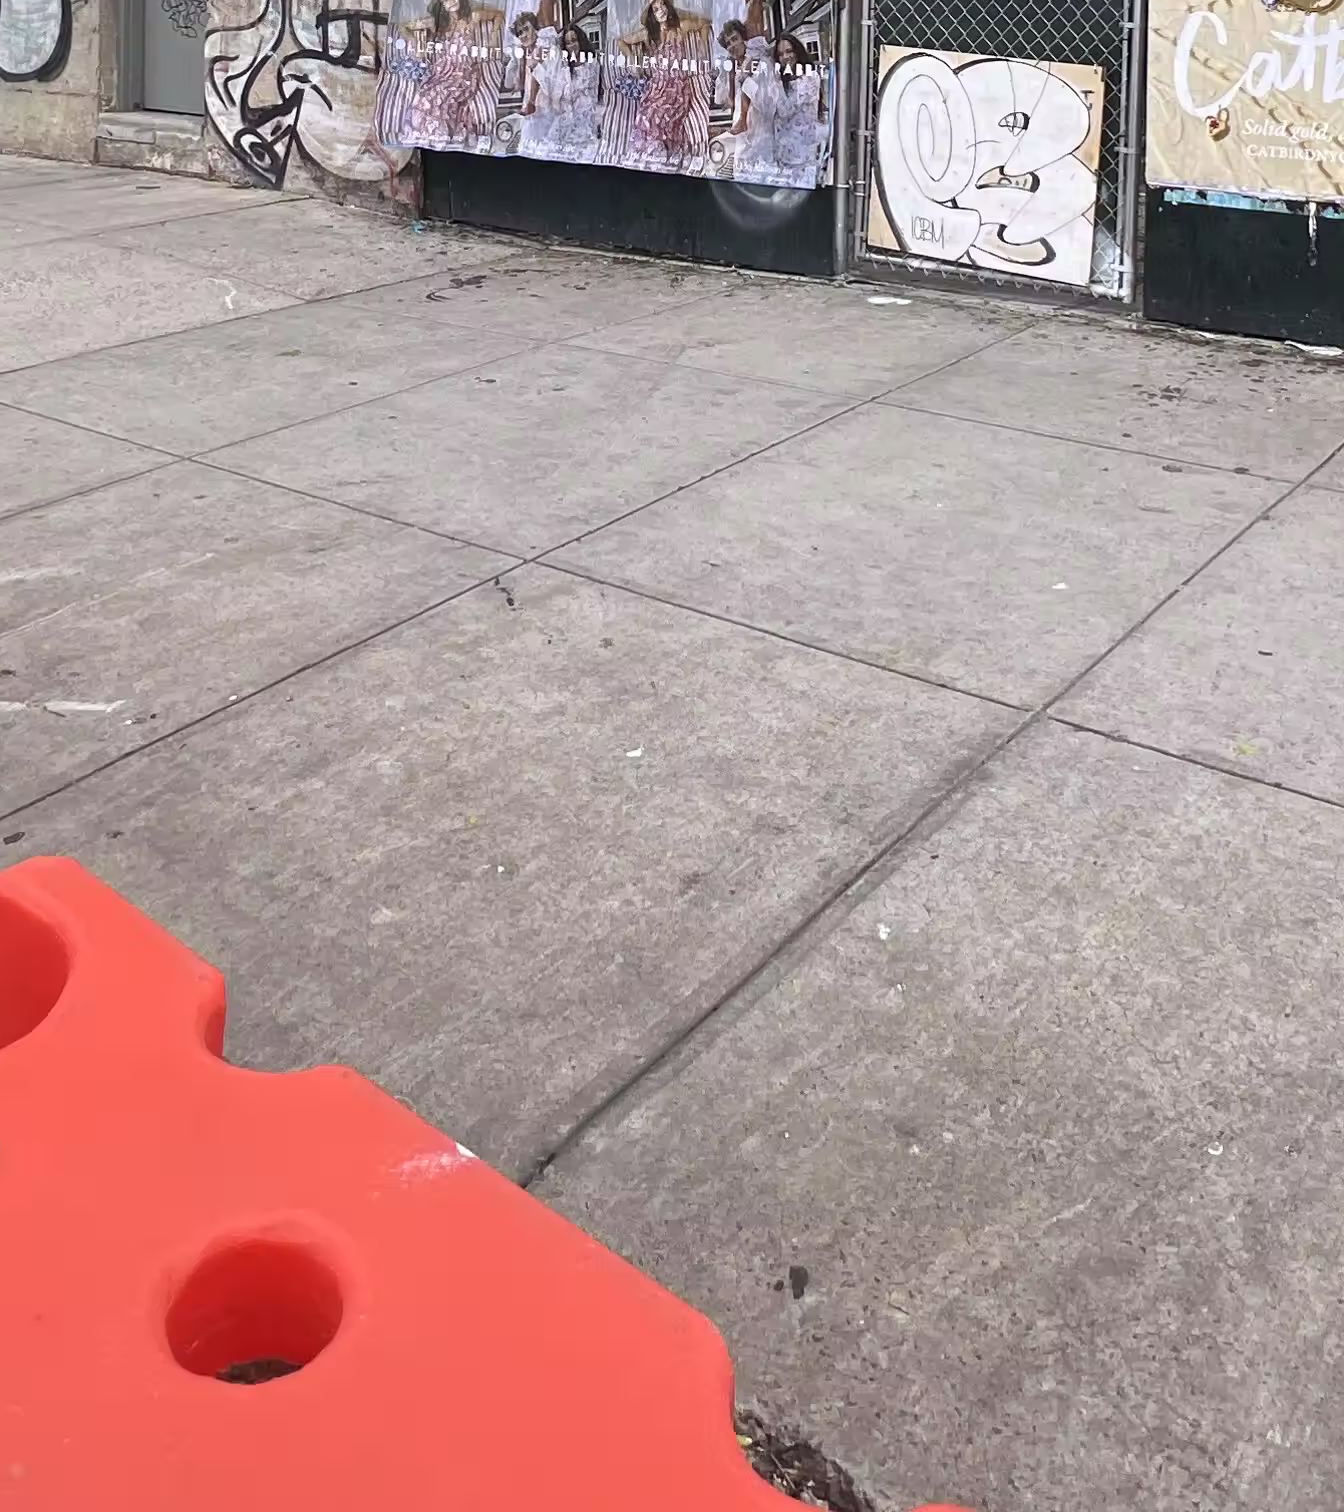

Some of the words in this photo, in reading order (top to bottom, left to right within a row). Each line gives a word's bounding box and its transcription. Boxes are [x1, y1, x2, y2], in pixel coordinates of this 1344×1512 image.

[449, 45, 501, 60] RABBIT
[562, 49, 605, 64] RABBIT
[609, 52, 656, 69] ROLLER
[661, 57, 710, 74] RABBIT
[715, 58, 768, 75] ROLLER
[774, 61, 829, 79] RABBIT
[1242, 118, 1287, 137] Solid
[1288, 121, 1334, 143] gold,
